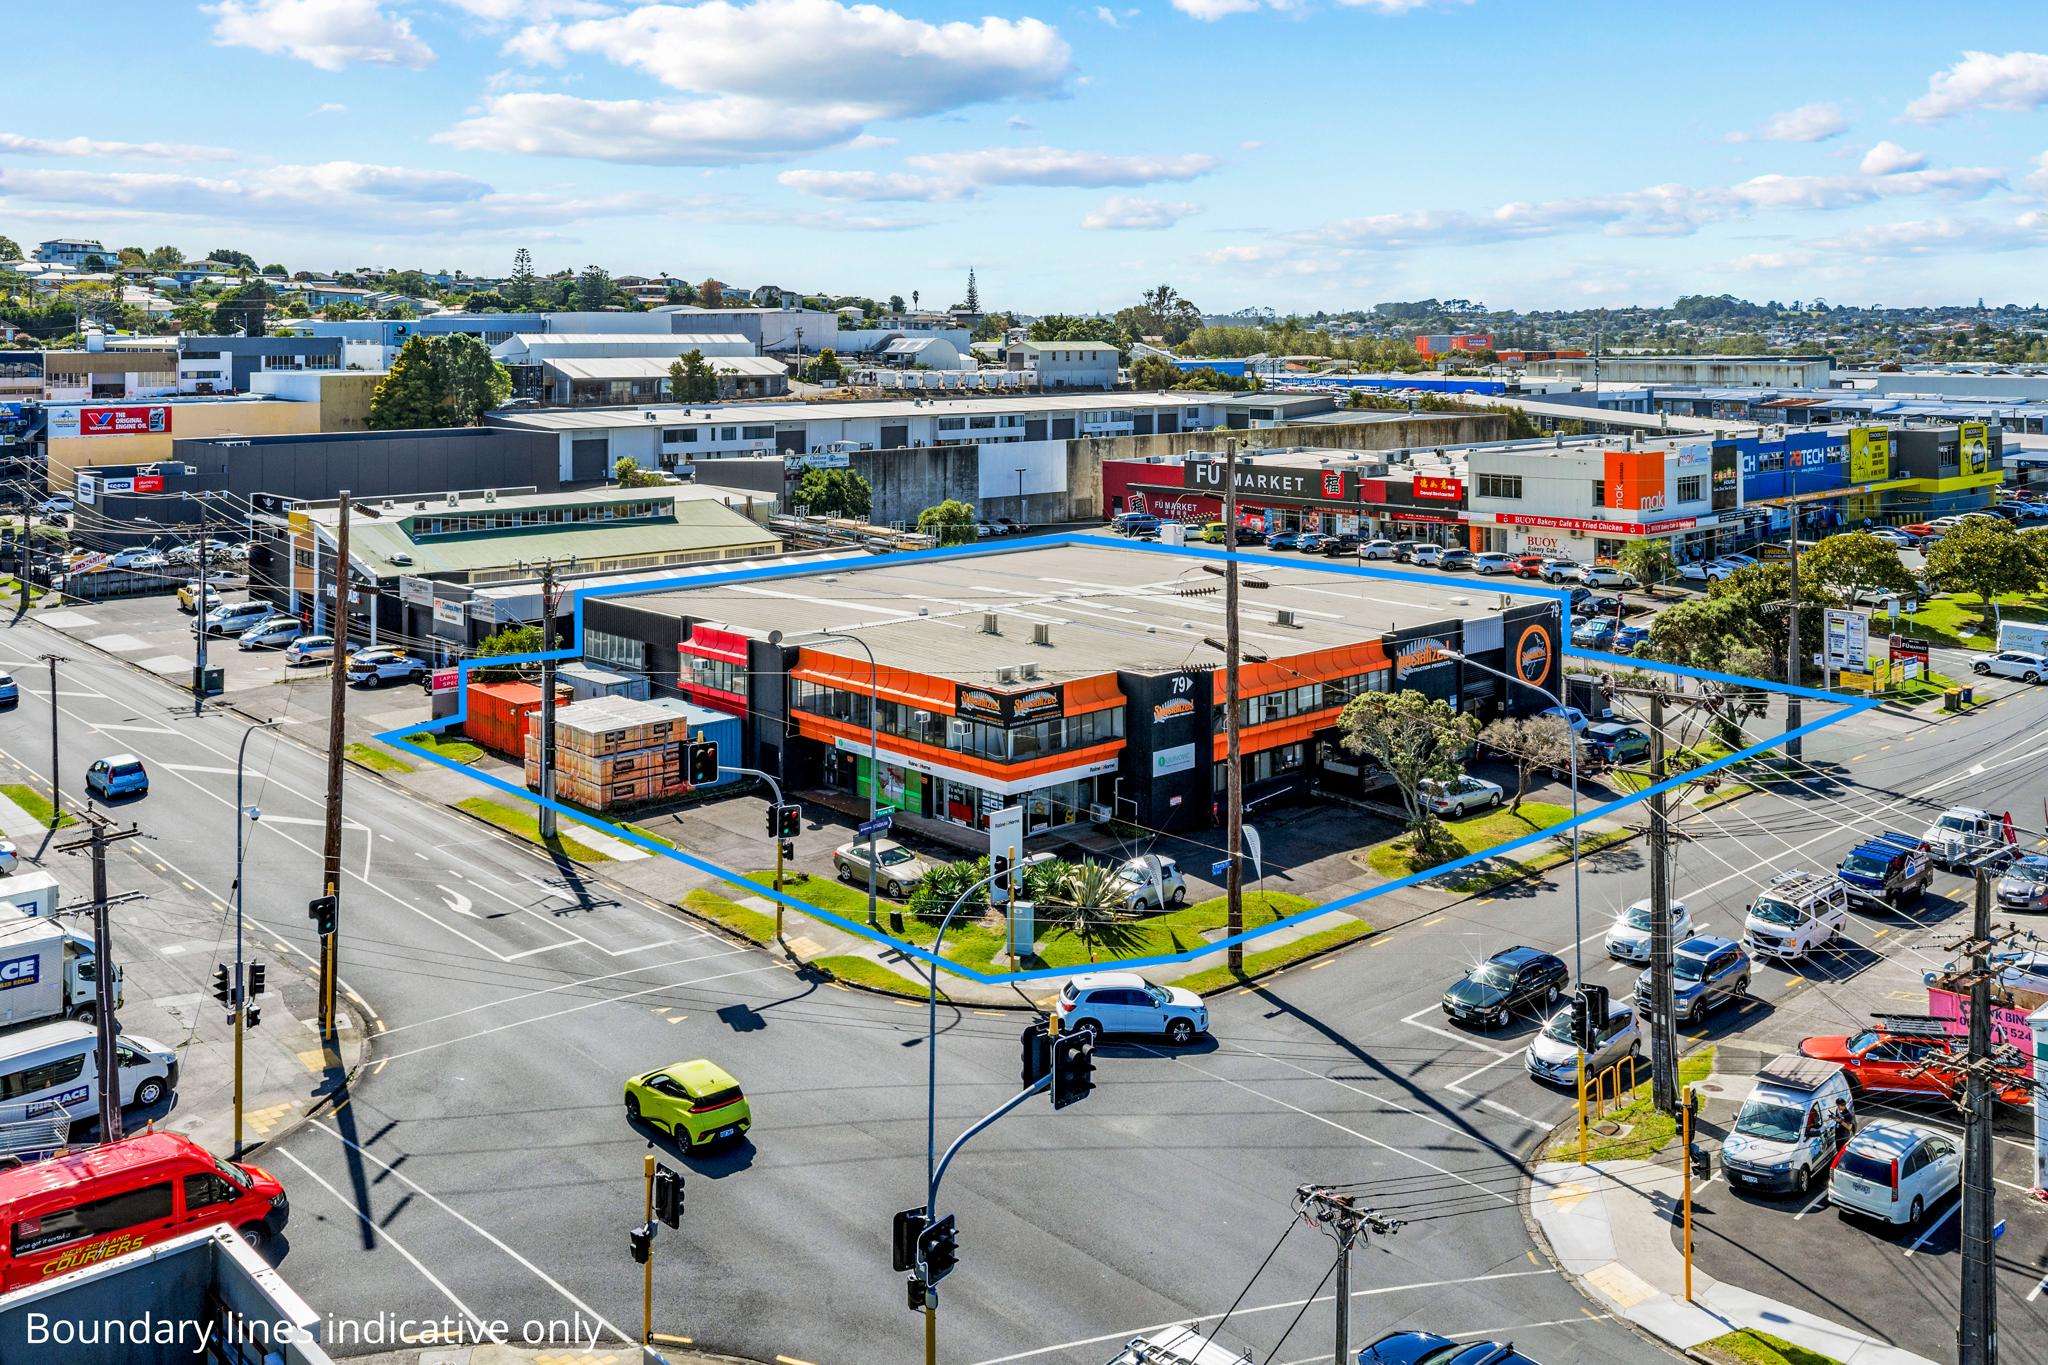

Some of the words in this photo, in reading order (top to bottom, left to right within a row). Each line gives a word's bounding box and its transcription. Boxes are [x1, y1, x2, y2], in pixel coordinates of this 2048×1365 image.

[1234, 474, 1304, 491] MARKET
[1515, 516, 1536, 524] BUOY
[1537, 518, 1557, 528] Bakery
[1559, 519, 1573, 528] Cafe
[1582, 521, 1598, 529] Fried
[1598, 522, 1623, 532] Chicken
[1527, 536, 1558, 548] BUOY
[1550, 604, 1560, 618] 79
[1171, 676, 1186, 694] 79
[2010, 1028, 2032, 1041] 524
[42, 1236, 147, 1275] COURIERS
[61, 1247, 83, 1259] NEW
